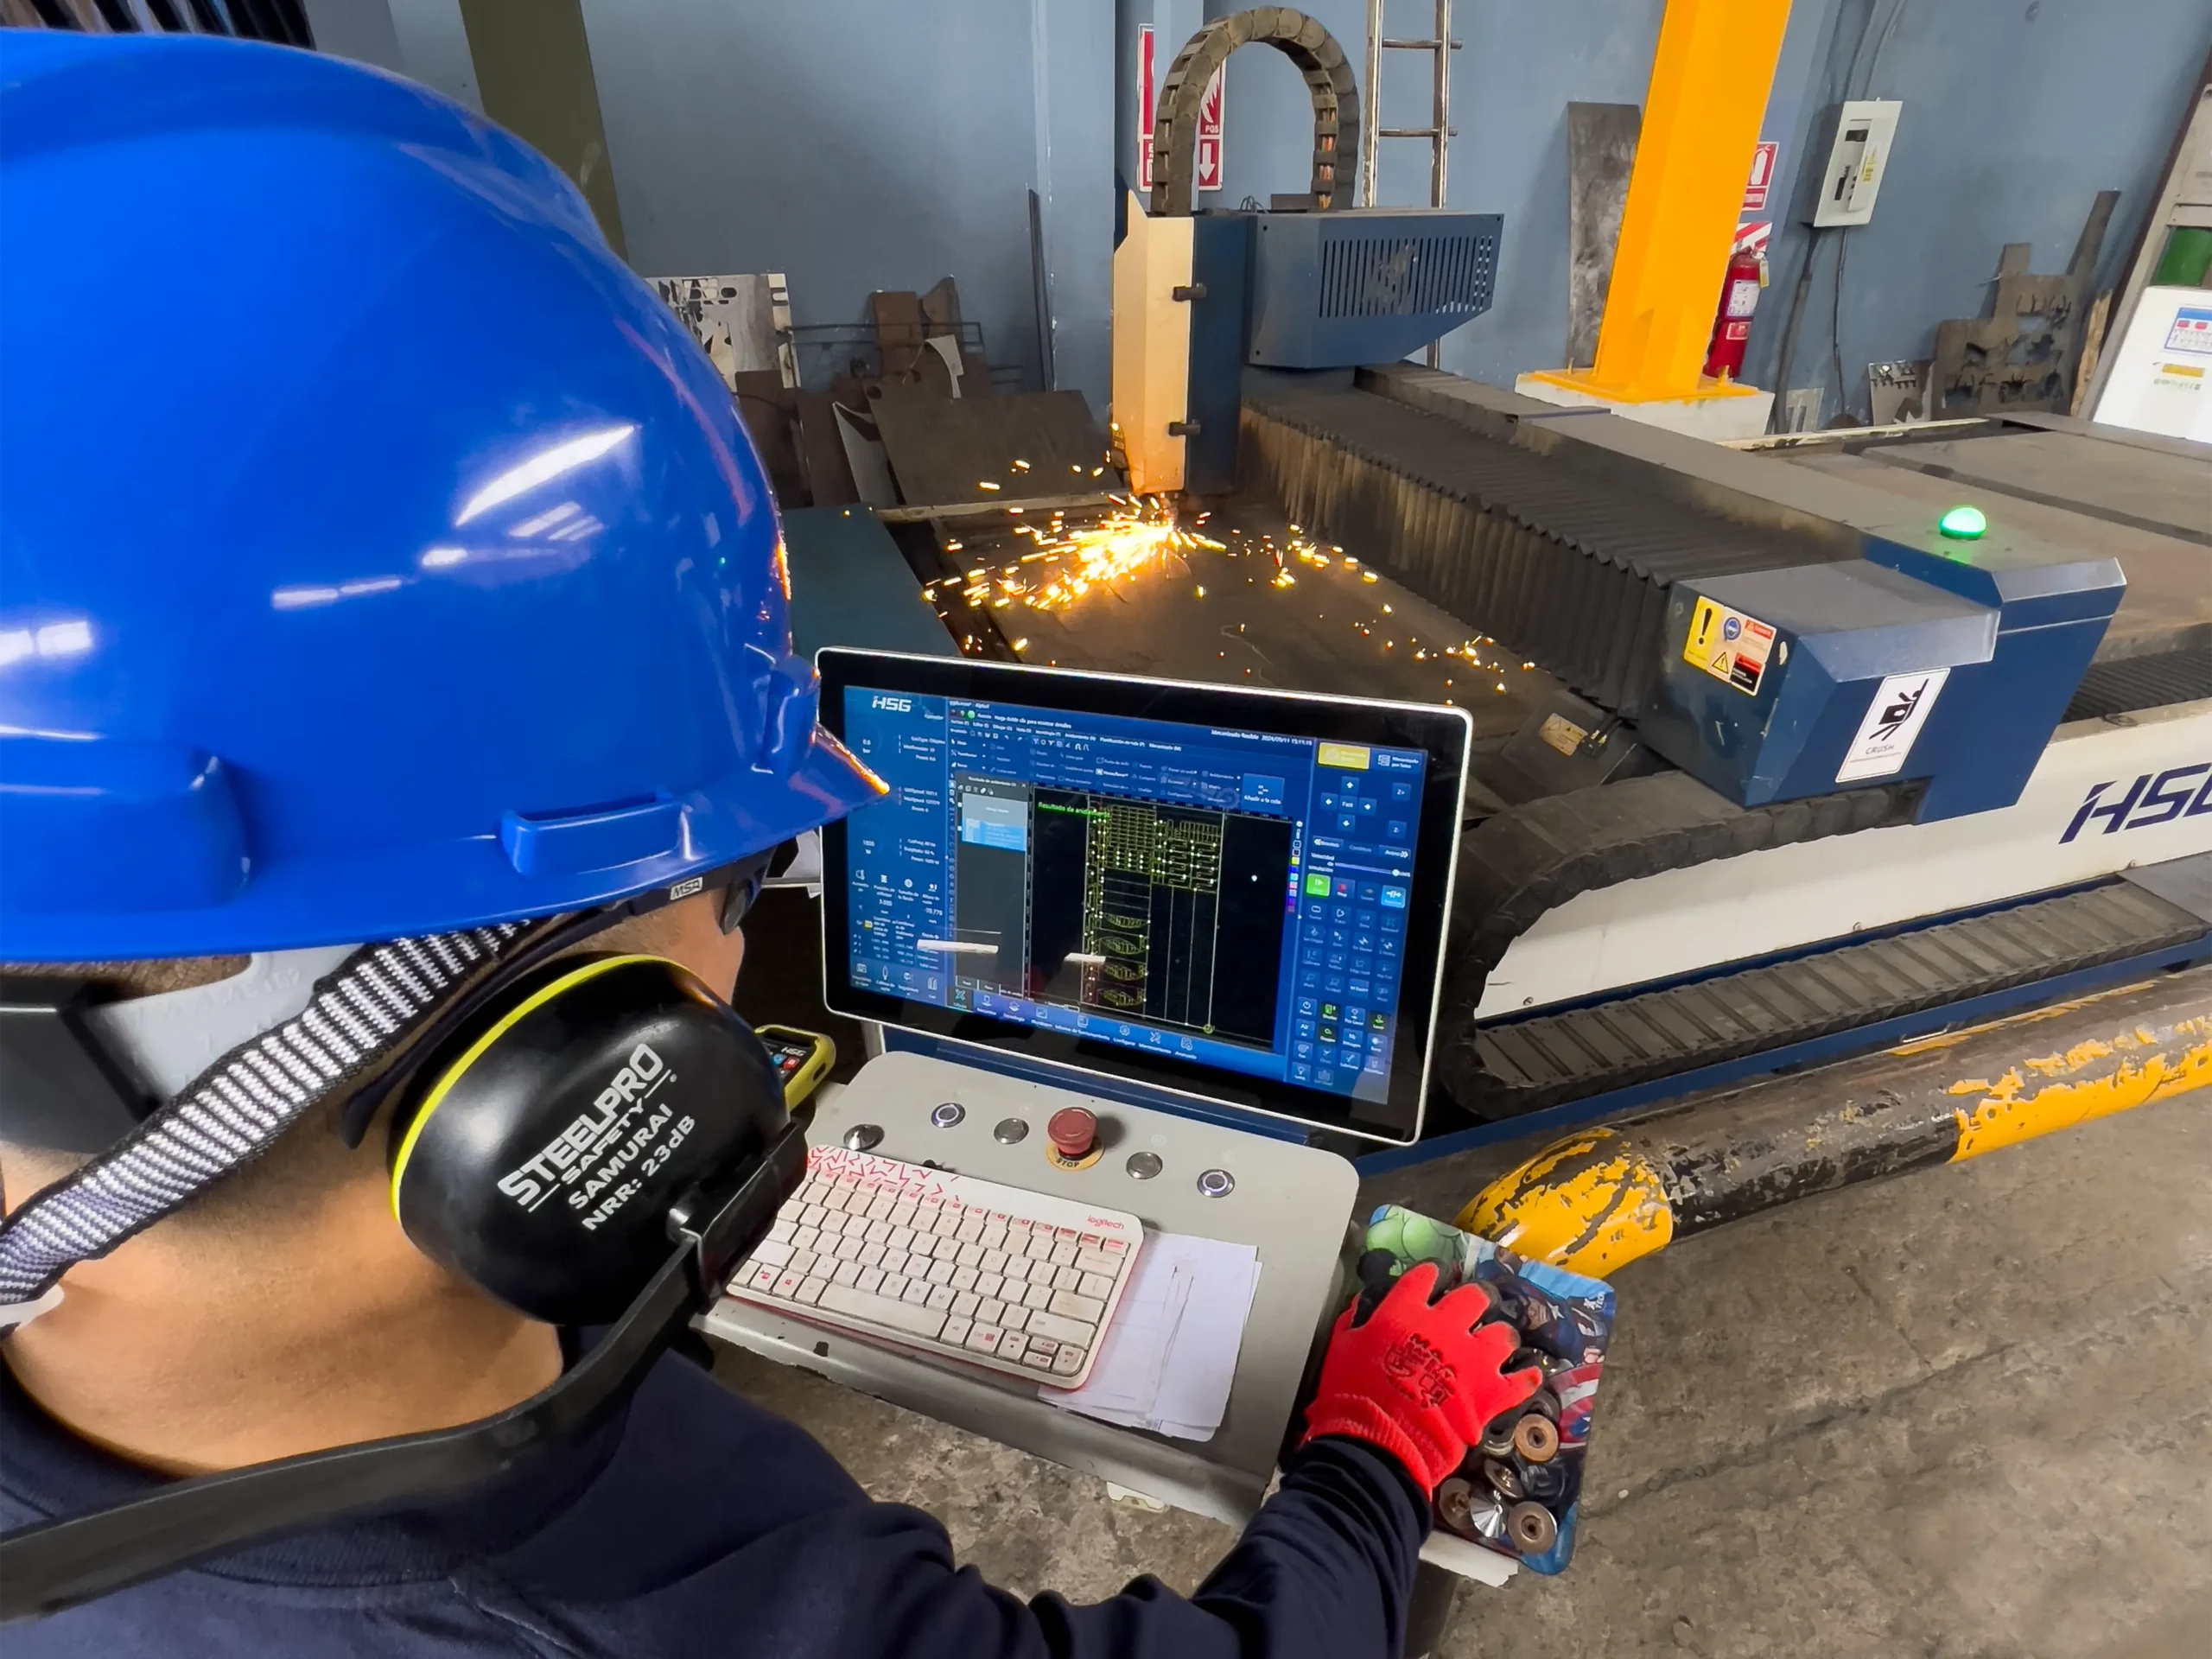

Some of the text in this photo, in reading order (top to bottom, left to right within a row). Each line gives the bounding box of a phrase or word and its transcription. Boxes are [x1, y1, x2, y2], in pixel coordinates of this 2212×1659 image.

[1205, 124, 1219, 134] PQS
[872, 696, 912, 712] HSG
[1866, 744, 1895, 754] CRUSH
[1039, 802, 1065, 811] Resultado
[673, 880, 701, 898] MSA
[497, 1043, 664, 1205] STEELPRO
[561, 1097, 644, 1185] SAFETY
[568, 1103, 673, 1209] SAMURAI
[1056, 1158, 1079, 1167] STOP
[582, 1116, 696, 1230] NRR: 23dB
[1088, 1215, 1124, 1230] logitech
